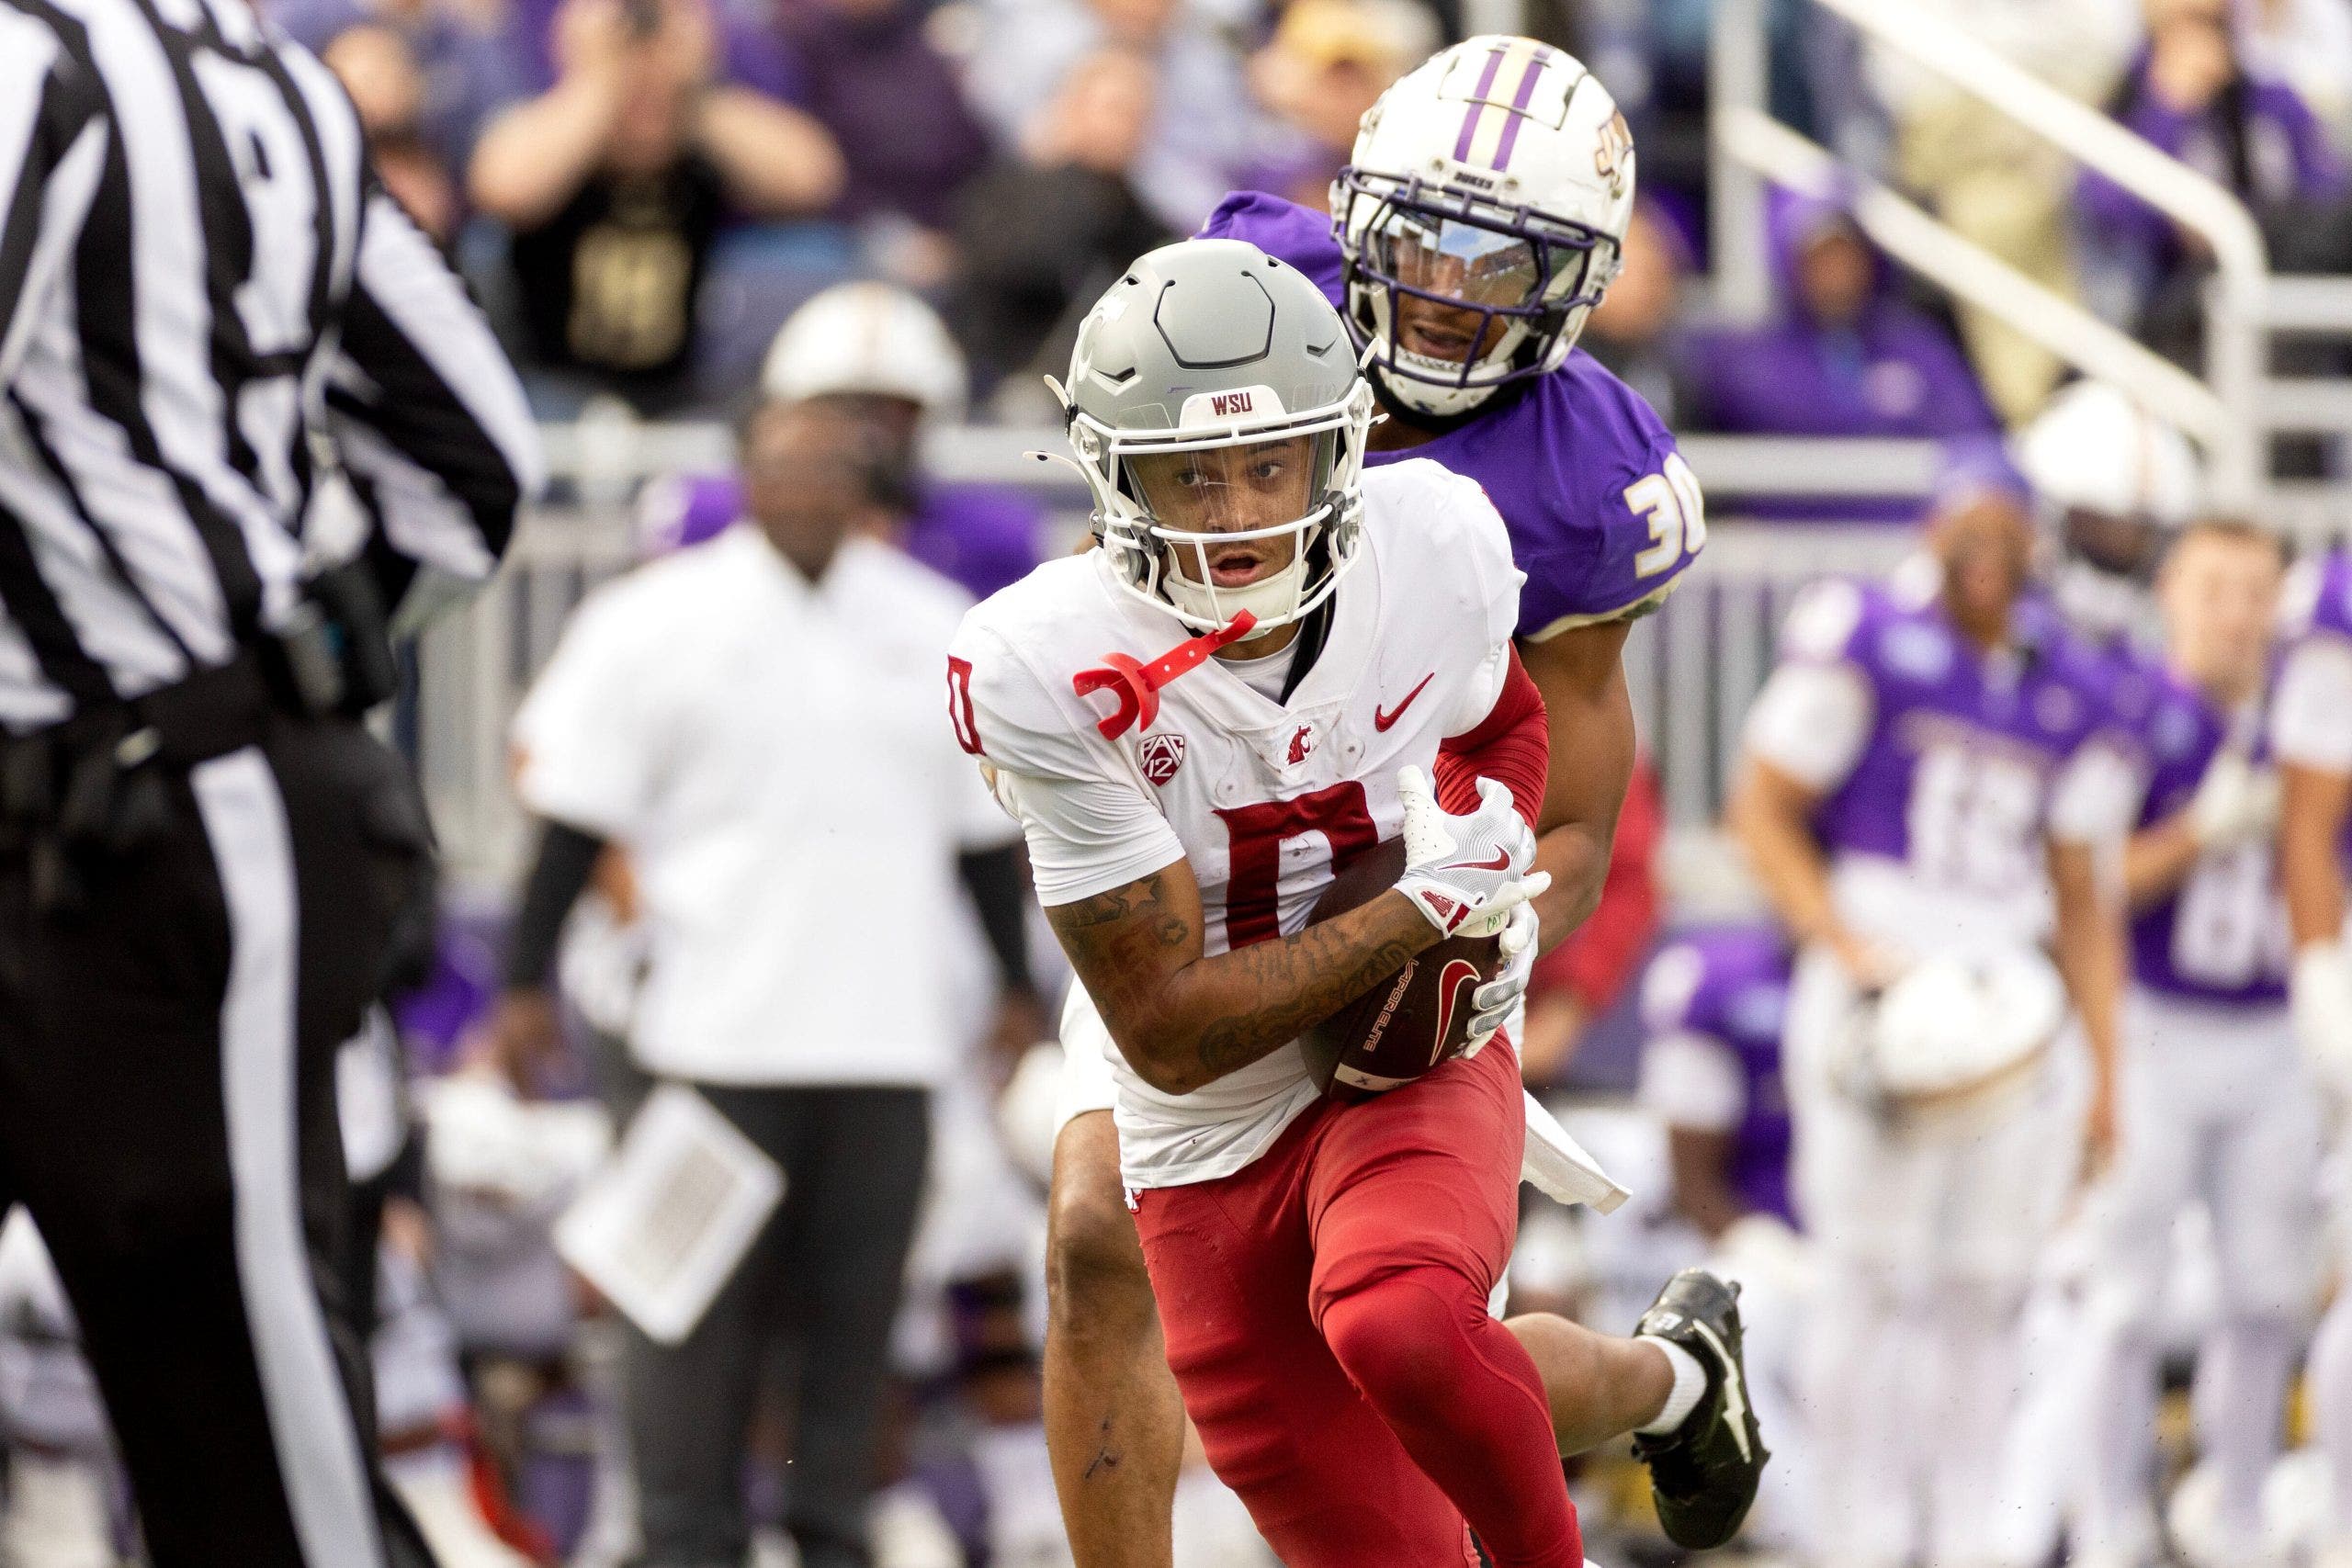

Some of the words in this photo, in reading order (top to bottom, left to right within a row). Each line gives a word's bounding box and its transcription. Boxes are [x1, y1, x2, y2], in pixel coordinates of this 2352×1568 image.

[1211, 391, 1252, 416] WSU
[1623, 451, 1707, 580] 30
[1139, 734, 1185, 769] PAC
[1148, 757, 1173, 778] 12
[1383, 957, 1419, 1012] VAPOR
[1363, 1010, 1391, 1053] ELITE
